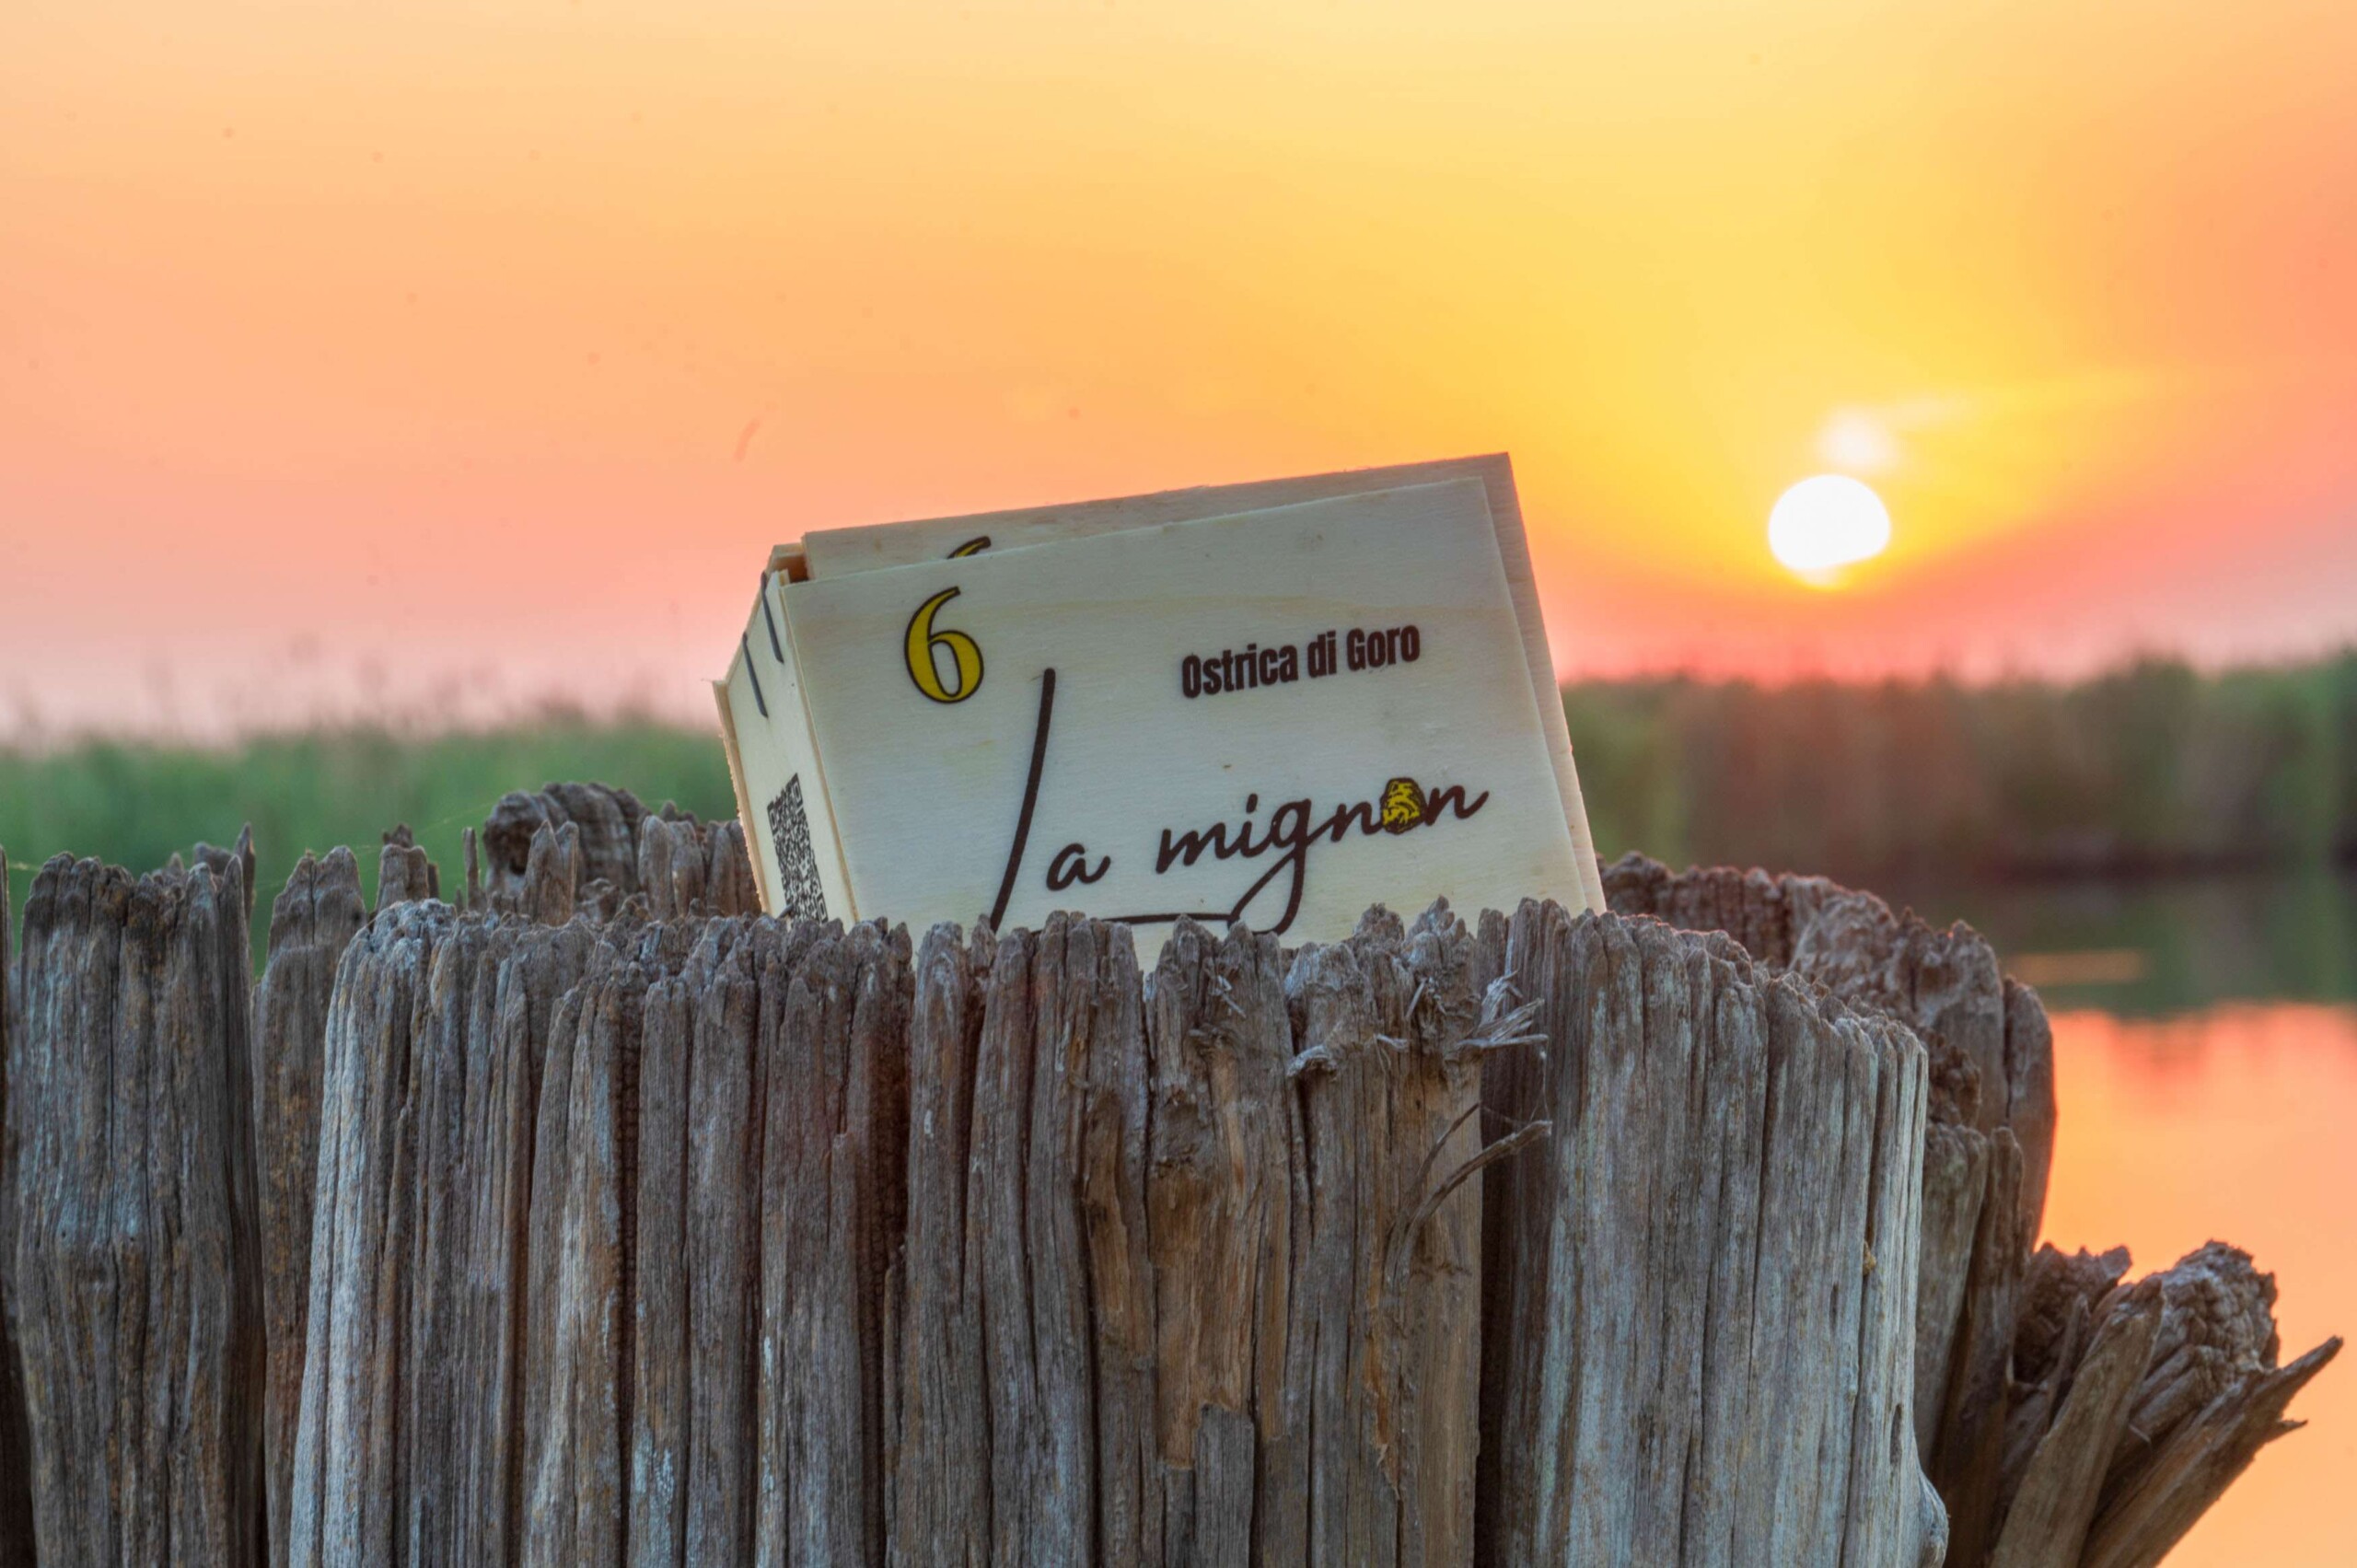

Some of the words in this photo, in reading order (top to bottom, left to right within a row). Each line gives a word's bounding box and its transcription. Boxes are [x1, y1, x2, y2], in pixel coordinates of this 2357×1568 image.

[904, 586, 984, 704] 6
[1181, 643, 1299, 699] Ostrica
[1307, 630, 1338, 678] di
[1346, 624, 1421, 671] Goro
